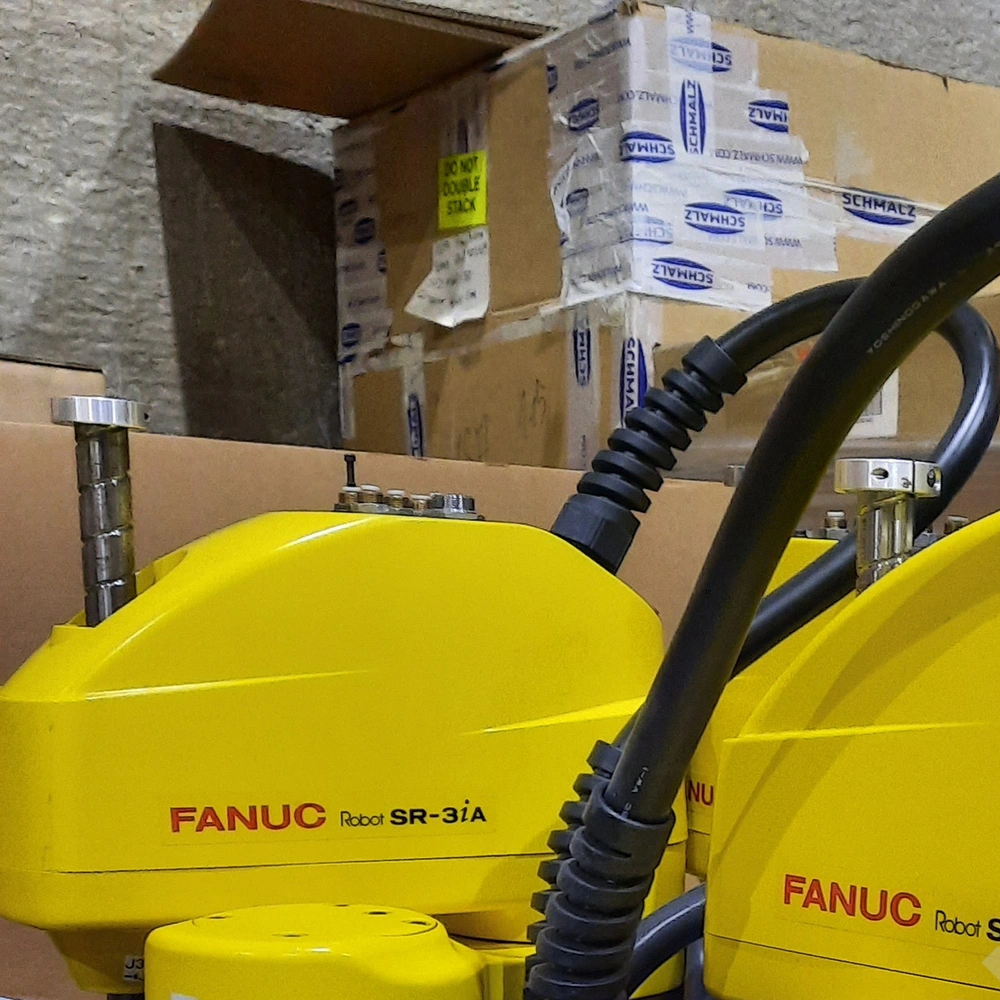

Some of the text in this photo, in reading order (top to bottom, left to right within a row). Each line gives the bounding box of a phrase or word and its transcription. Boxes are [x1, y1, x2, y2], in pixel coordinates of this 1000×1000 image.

[687, 80, 699, 154] SCHMALZ
[684, 208, 746, 228] SCHMALZ
[842, 192, 917, 218] SCHMALZ
[652, 263, 714, 284] SCHMALZ
[169, 799, 487, 834] FANUC Robot SR-3iA
[783, 874, 922, 927] FANUC
[934, 909, 982, 938] Robot
